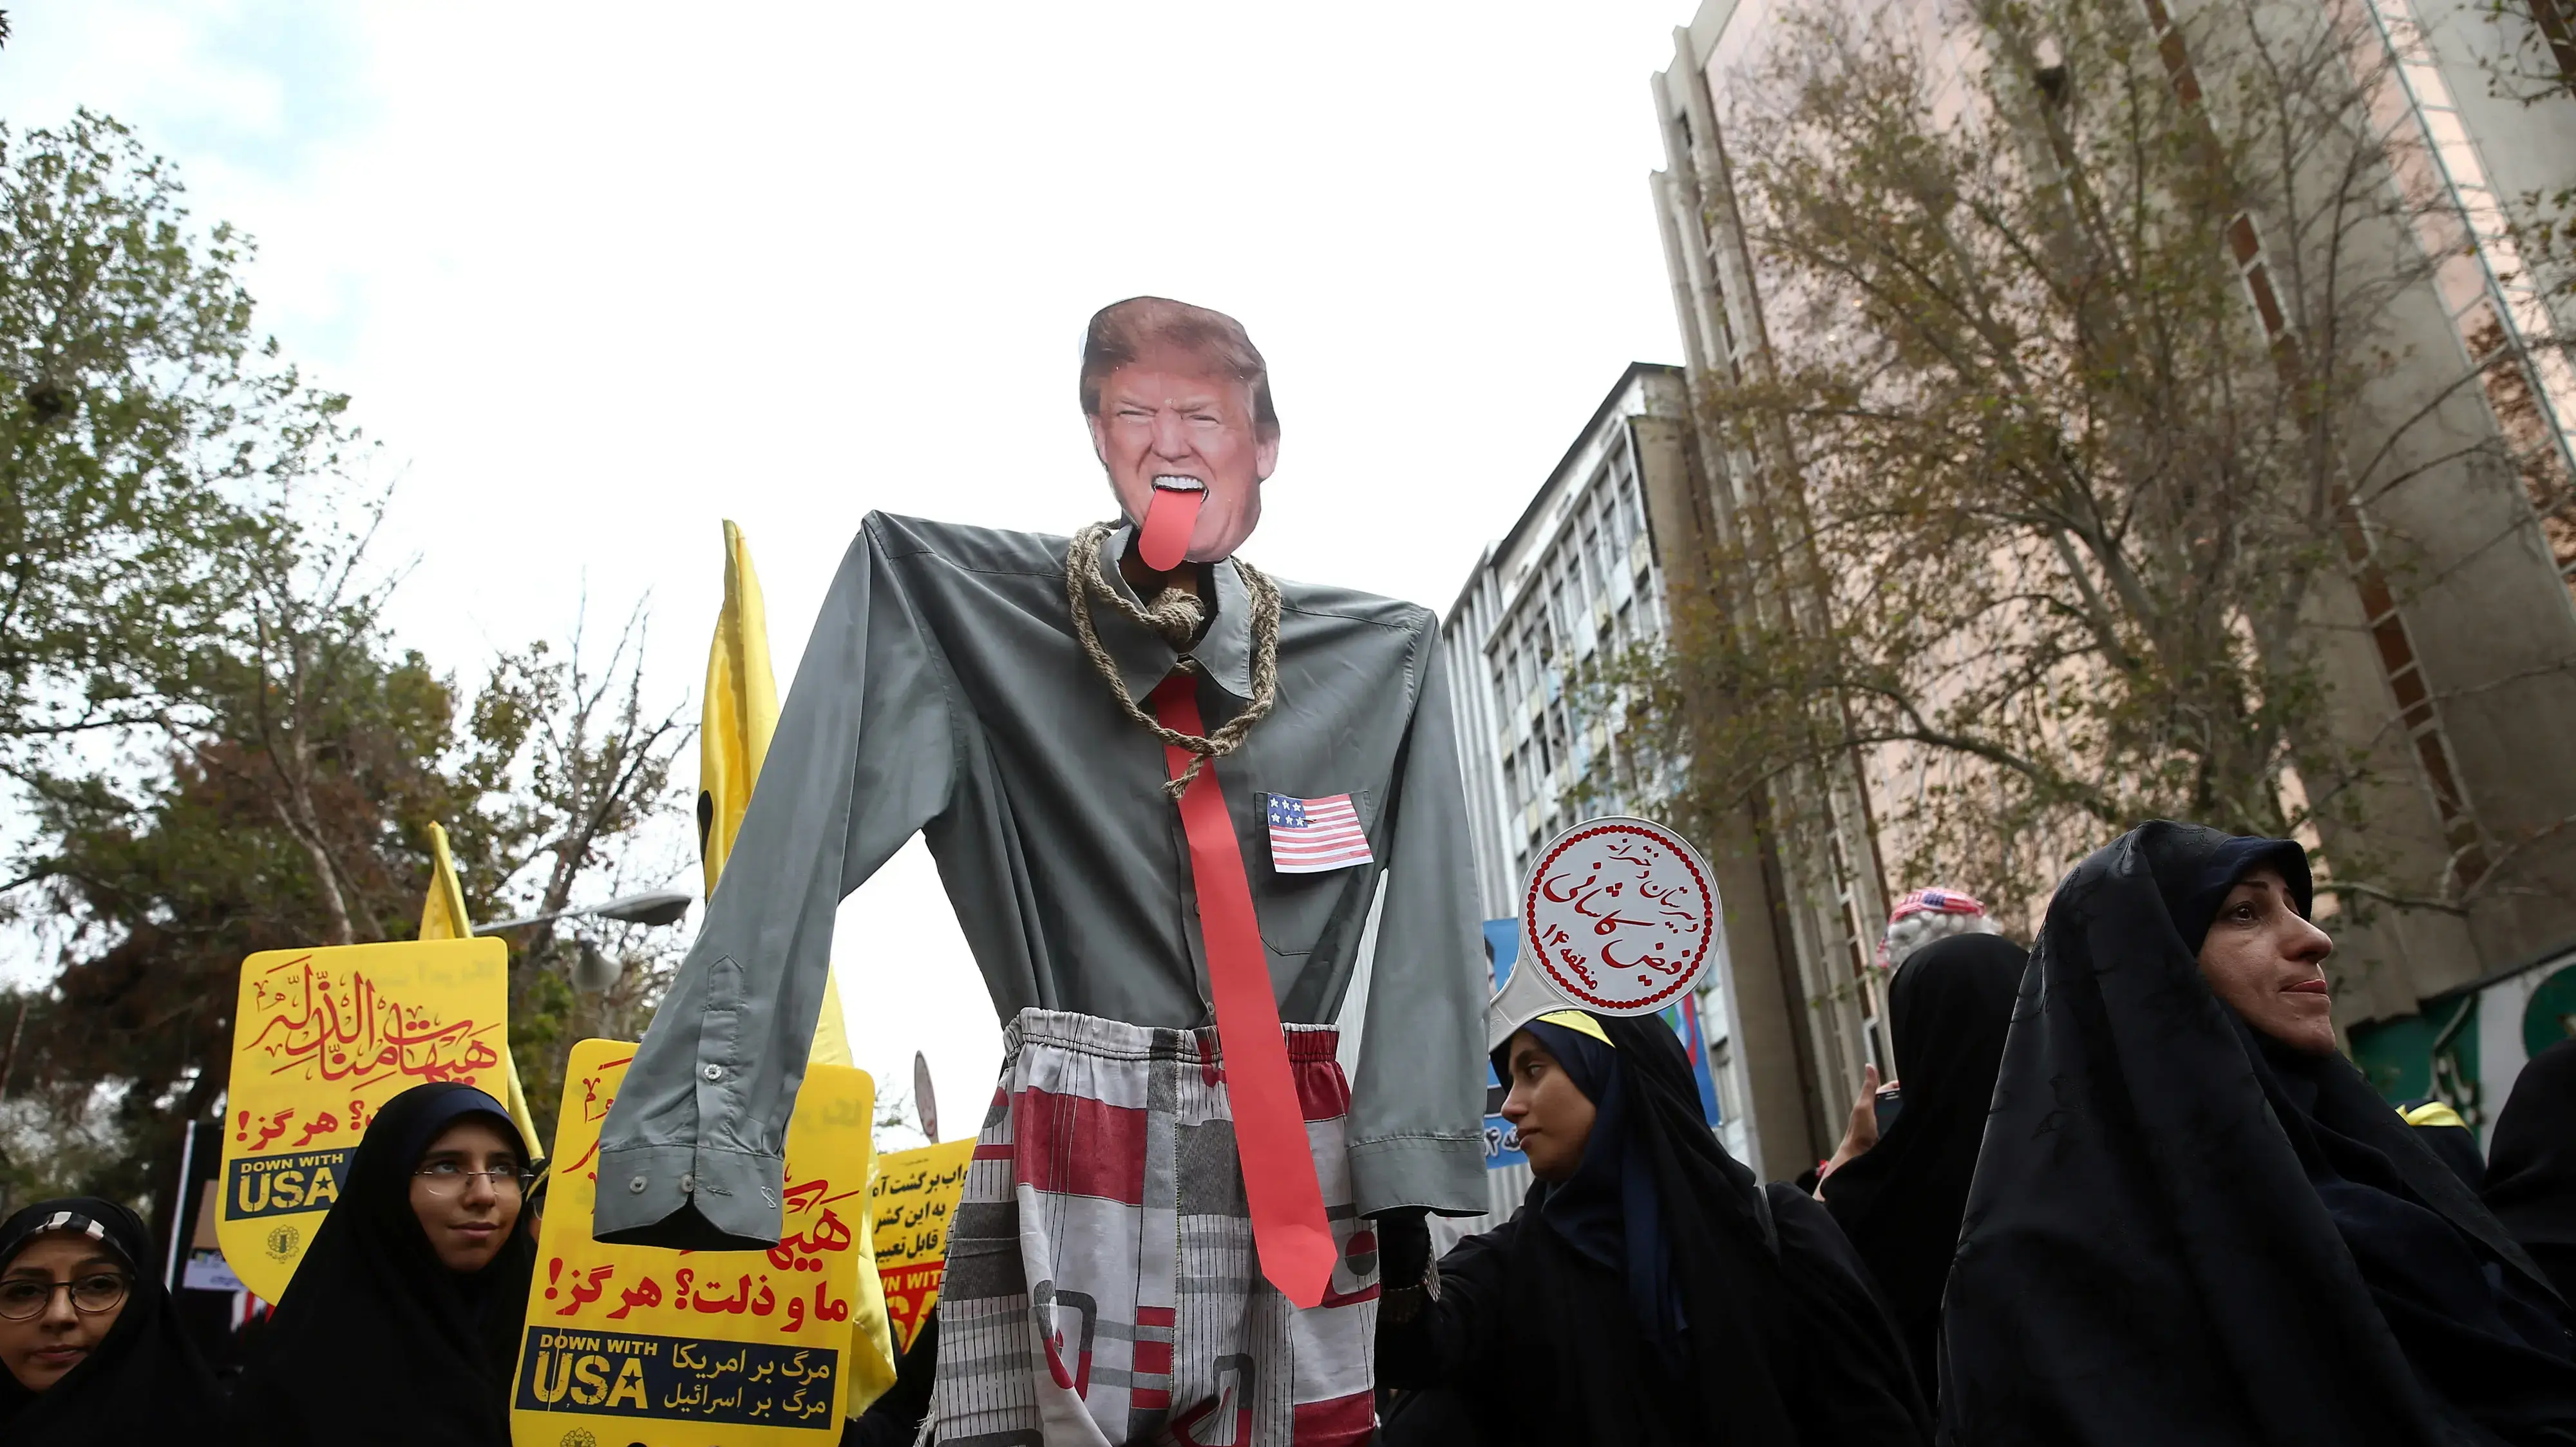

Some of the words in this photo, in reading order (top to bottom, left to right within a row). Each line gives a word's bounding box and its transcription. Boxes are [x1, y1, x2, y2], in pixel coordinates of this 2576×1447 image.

[1542, 862, 1656, 936] کاشانی
[1560, 947, 1598, 990] منطقه
[1601, 939, 1691, 987] فیض
[236, 1107, 339, 1151] هرگز!
[240, 1159, 293, 1174] DOWN
[299, 1153, 345, 1168] WITH
[238, 1166, 339, 1213] USA
[904, 1201, 931, 1228] این
[932, 1202, 946, 1222] به
[907, 1228, 939, 1259] قابل
[544, 1256, 663, 1320] هرگز!
[674, 1267, 776, 1317] ذلت؟
[907, 1269, 942, 1290] WIT
[779, 1296, 806, 1333] و
[813, 1280, 849, 1322] ما
[540, 1333, 601, 1352] DOWN
[607, 1338, 659, 1356] WITH
[672, 1343, 746, 1379] امریکا
[533, 1350, 649, 1410] USA
[748, 1359, 775, 1385] بر
[781, 1350, 830, 1385] مرگ
[663, 1382, 743, 1414] اسرائیل
[749, 1396, 772, 1418] بر
[782, 1388, 826, 1420] مرگ
